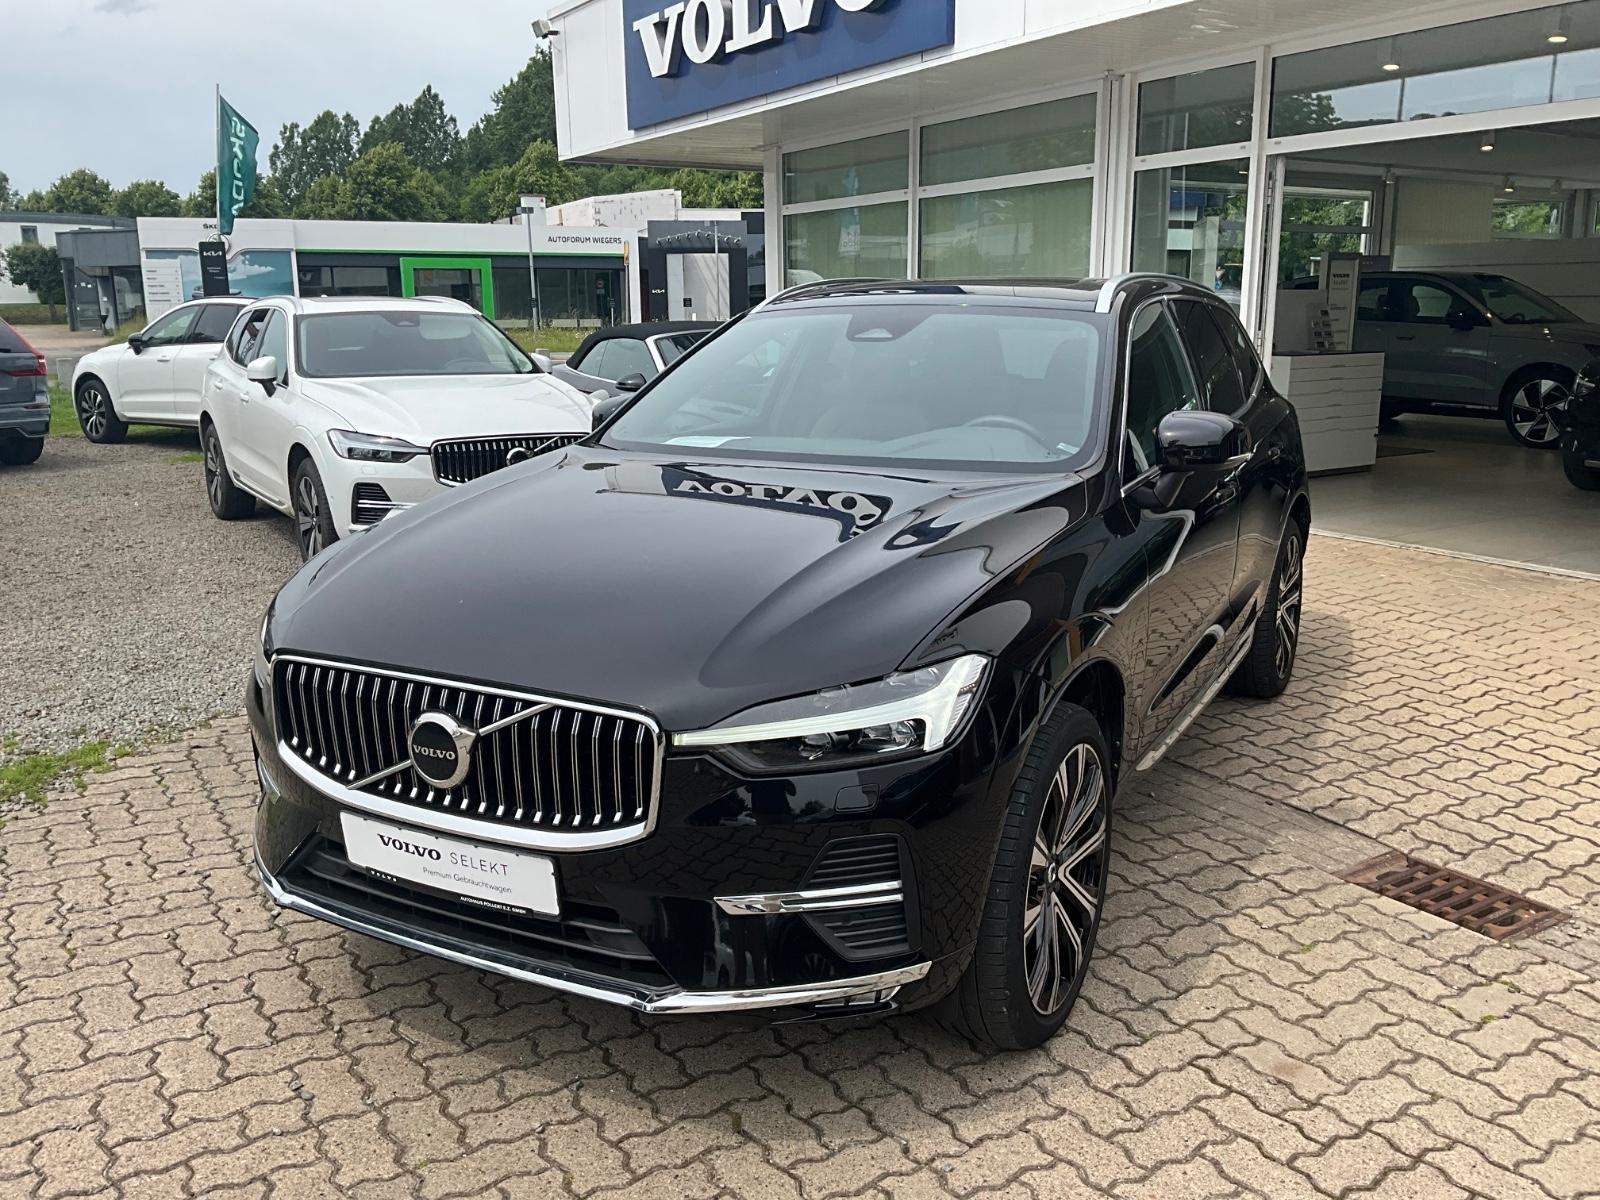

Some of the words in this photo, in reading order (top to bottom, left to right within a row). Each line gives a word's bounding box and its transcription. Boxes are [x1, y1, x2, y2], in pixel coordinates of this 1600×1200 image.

[547, 236, 591, 244] AUTOFORUM
[413, 744, 456, 760] VOLVO
[377, 833, 441, 861] VOLVO
[450, 851, 509, 876] SELEKT
[423, 866, 452, 880] Premium
[453, 873, 512, 894] Gebrauchtwagen
[460, 896, 483, 906] AUTOHAUS
